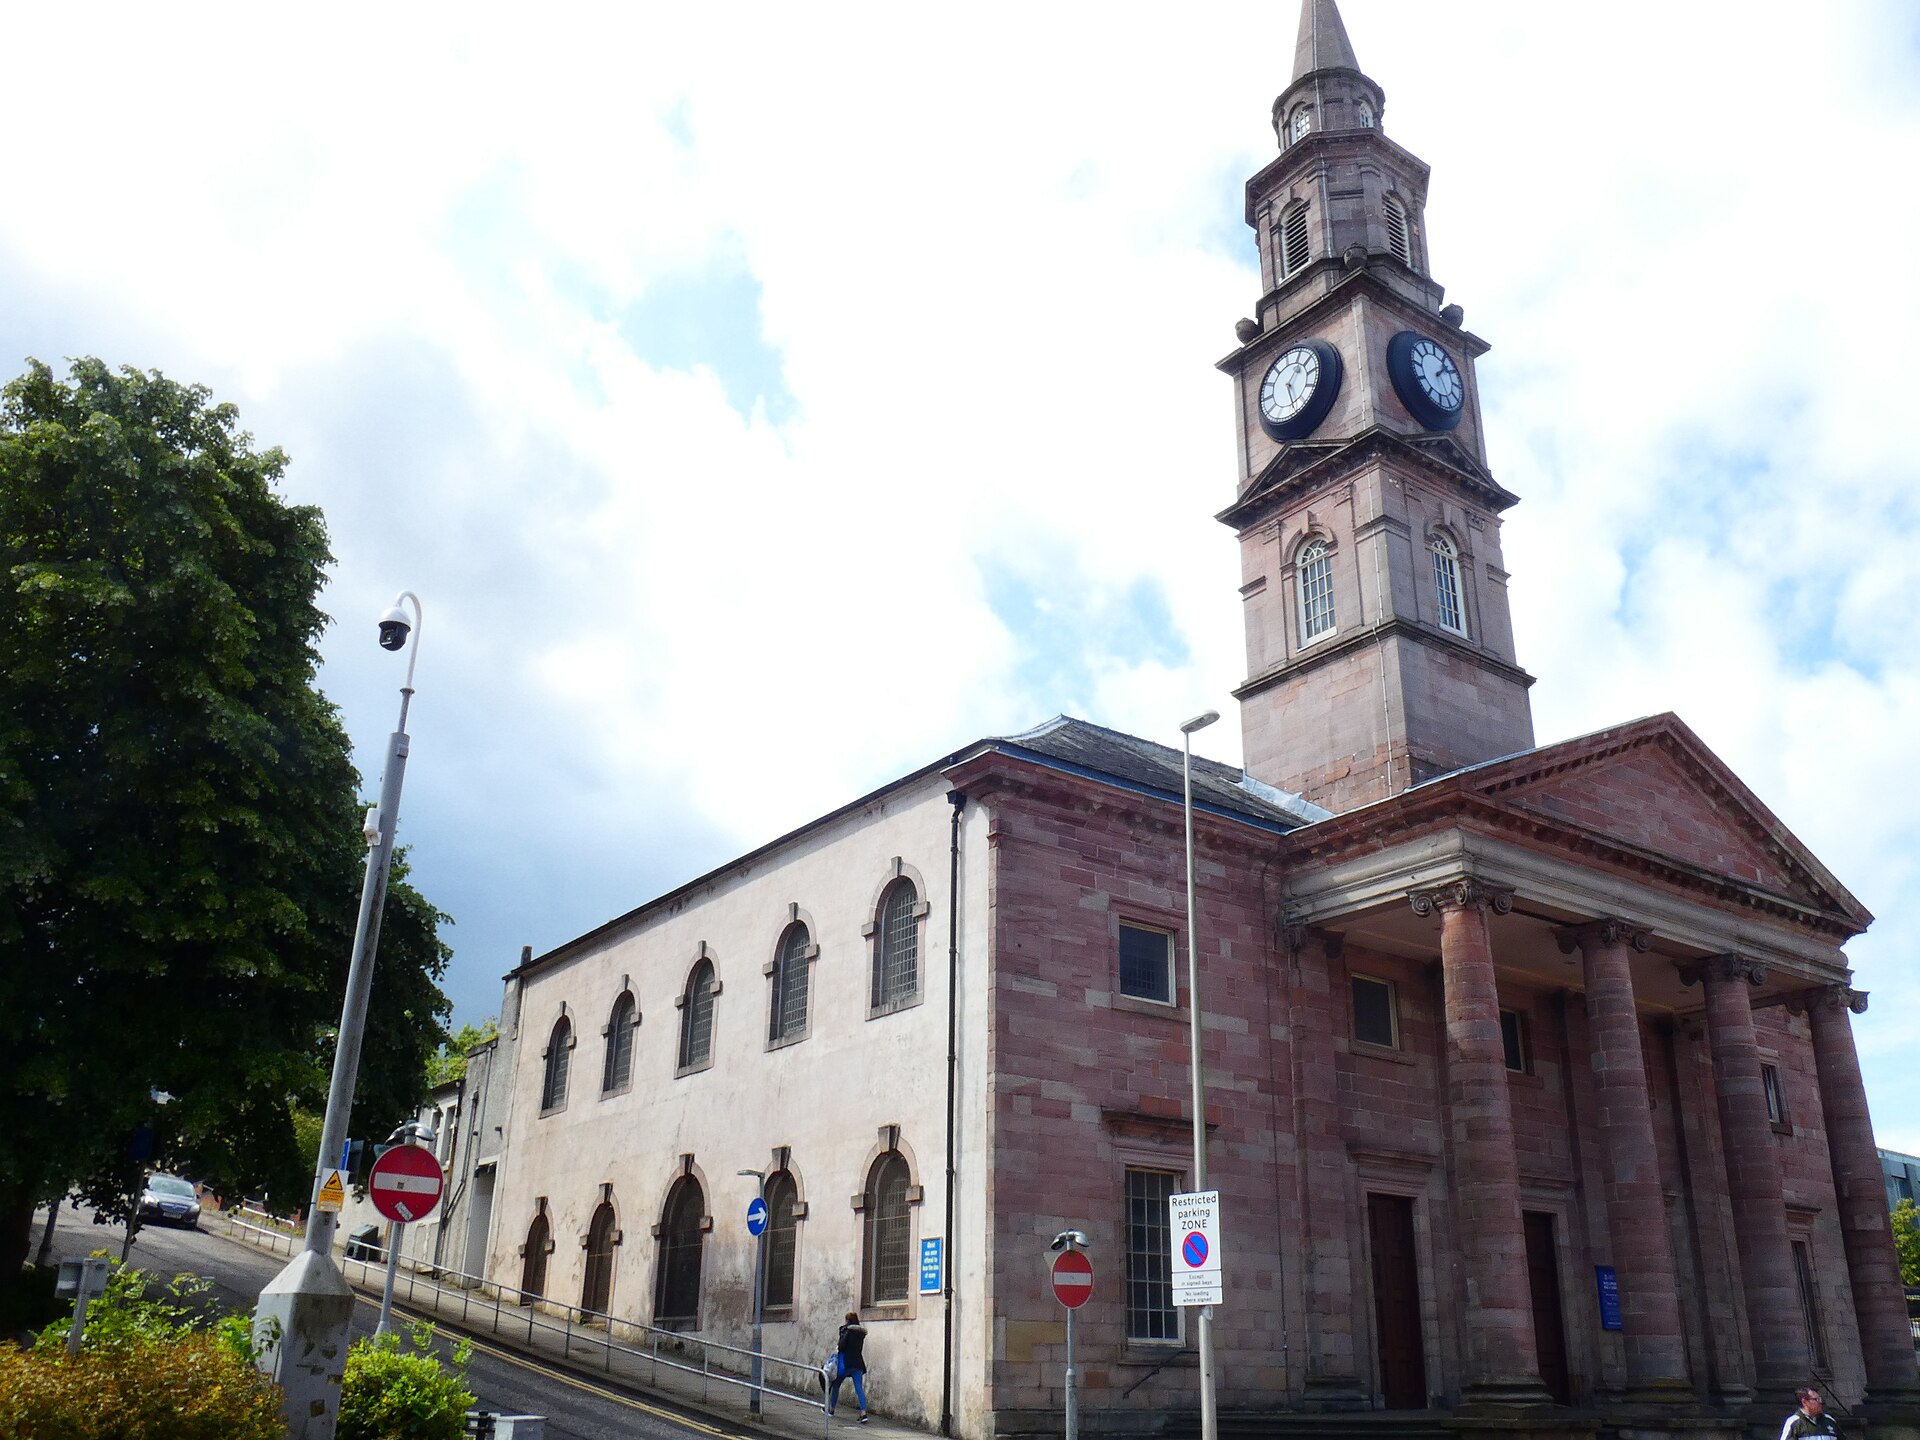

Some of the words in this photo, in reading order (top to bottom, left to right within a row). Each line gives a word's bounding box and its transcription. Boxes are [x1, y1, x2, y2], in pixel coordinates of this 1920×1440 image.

[1172, 1194, 1216, 1206] Restricted
[1178, 1208, 1210, 1219] parking
[1182, 1219, 1207, 1230] ZONE
